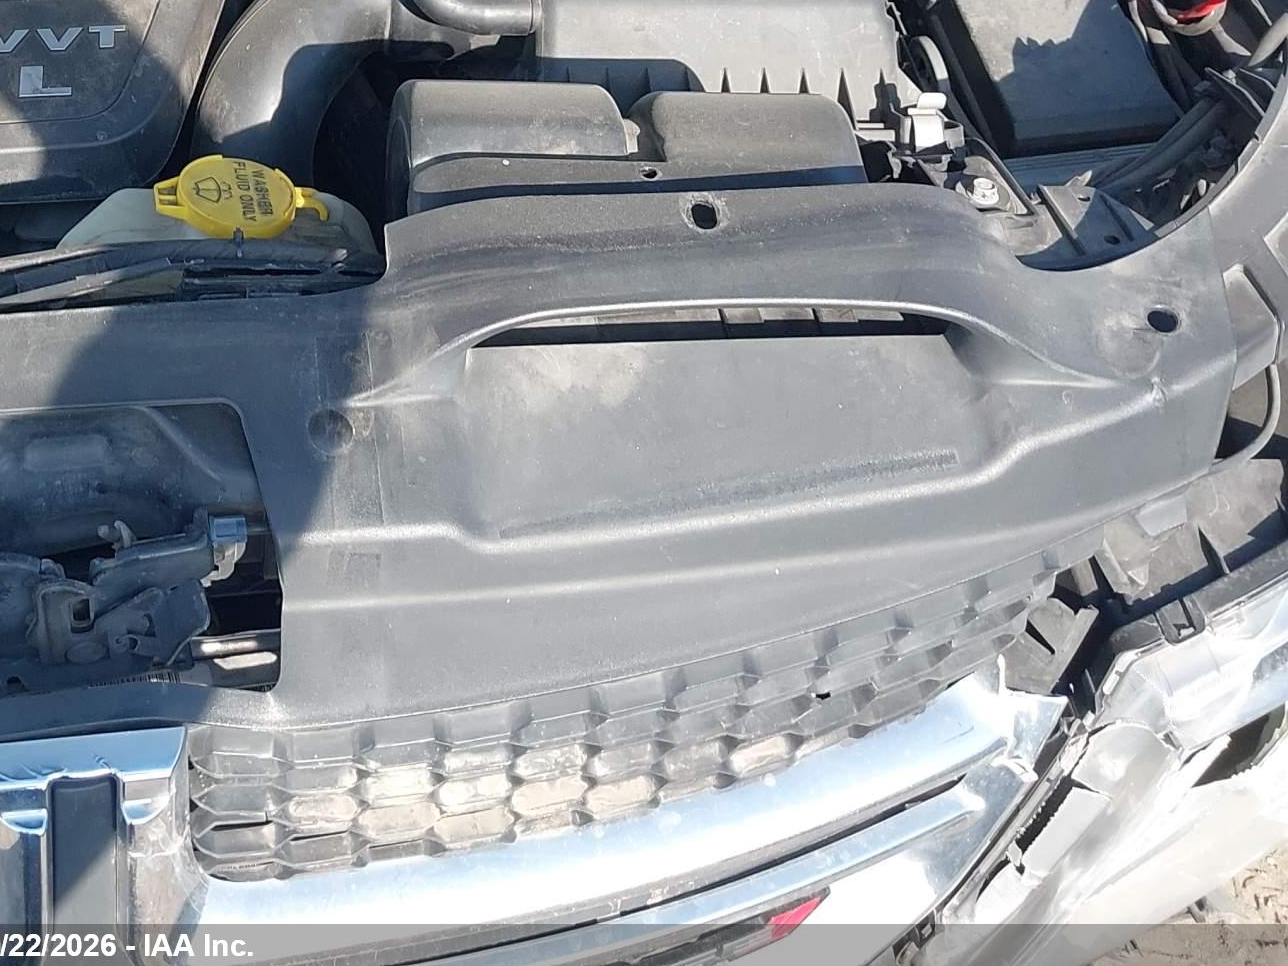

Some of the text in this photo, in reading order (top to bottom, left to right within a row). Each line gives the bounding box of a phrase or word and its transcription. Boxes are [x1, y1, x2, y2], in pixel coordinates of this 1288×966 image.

[18, 65, 73, 99] L
[232, 161, 257, 222] FLUID ONLY
[251, 169, 274, 216] WASHER
